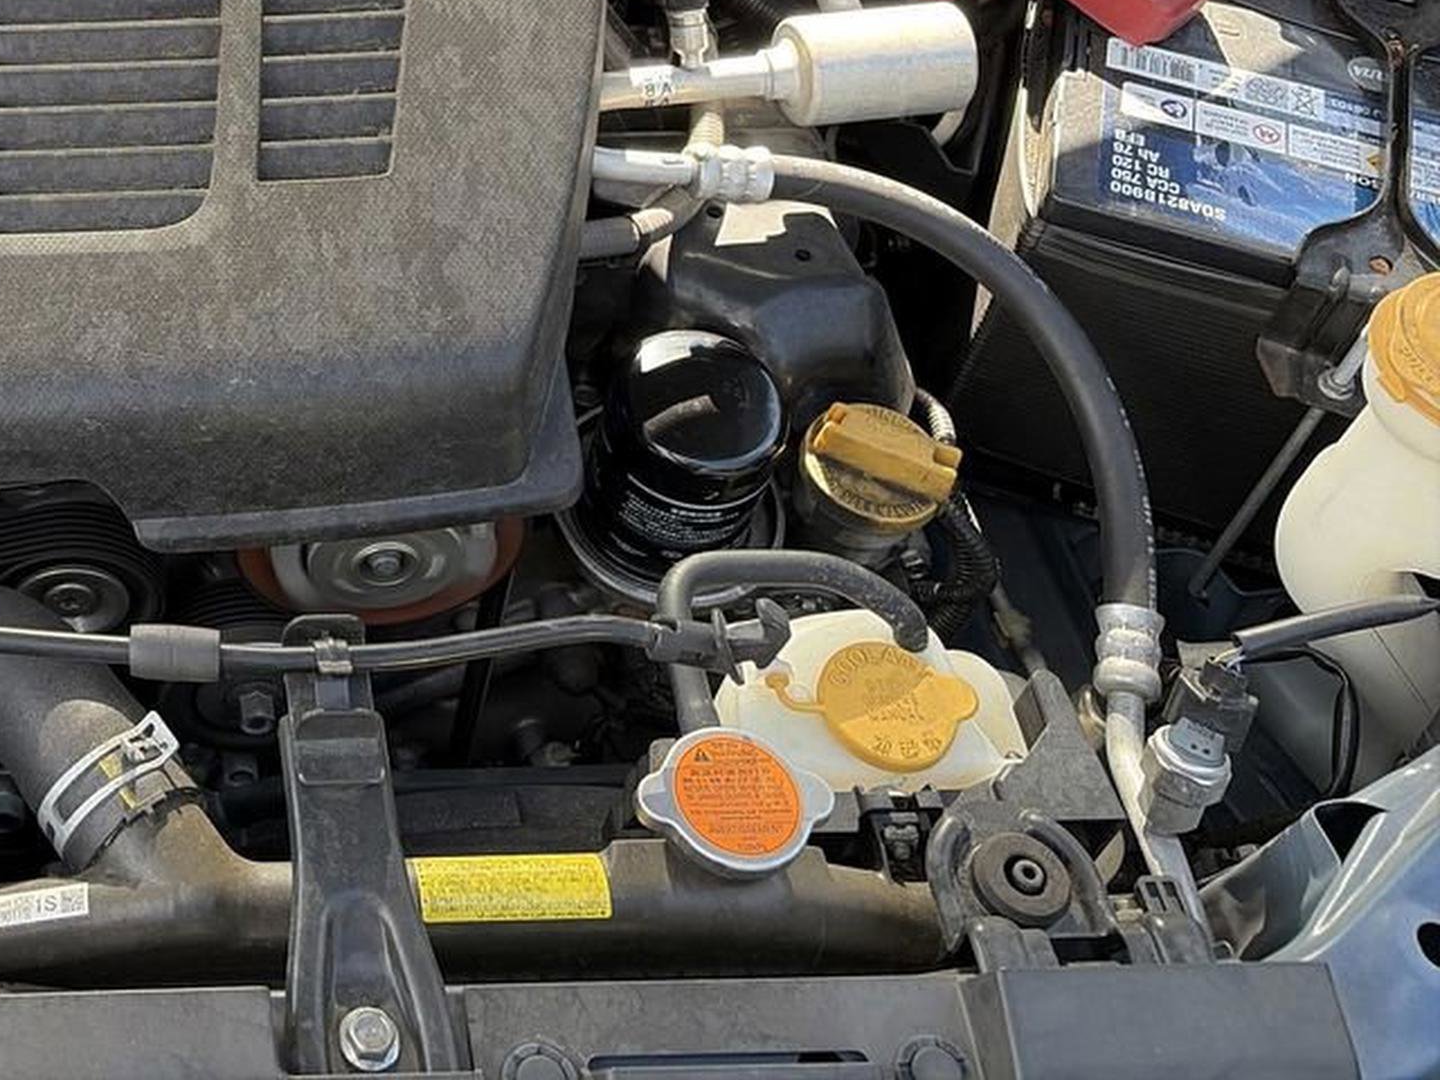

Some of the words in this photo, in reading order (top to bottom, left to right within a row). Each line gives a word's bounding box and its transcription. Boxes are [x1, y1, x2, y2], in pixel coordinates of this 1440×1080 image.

[1112, 154, 1142, 171] 120
[1146, 163, 1170, 179] RC
[1146, 176, 1180, 195] CCA
